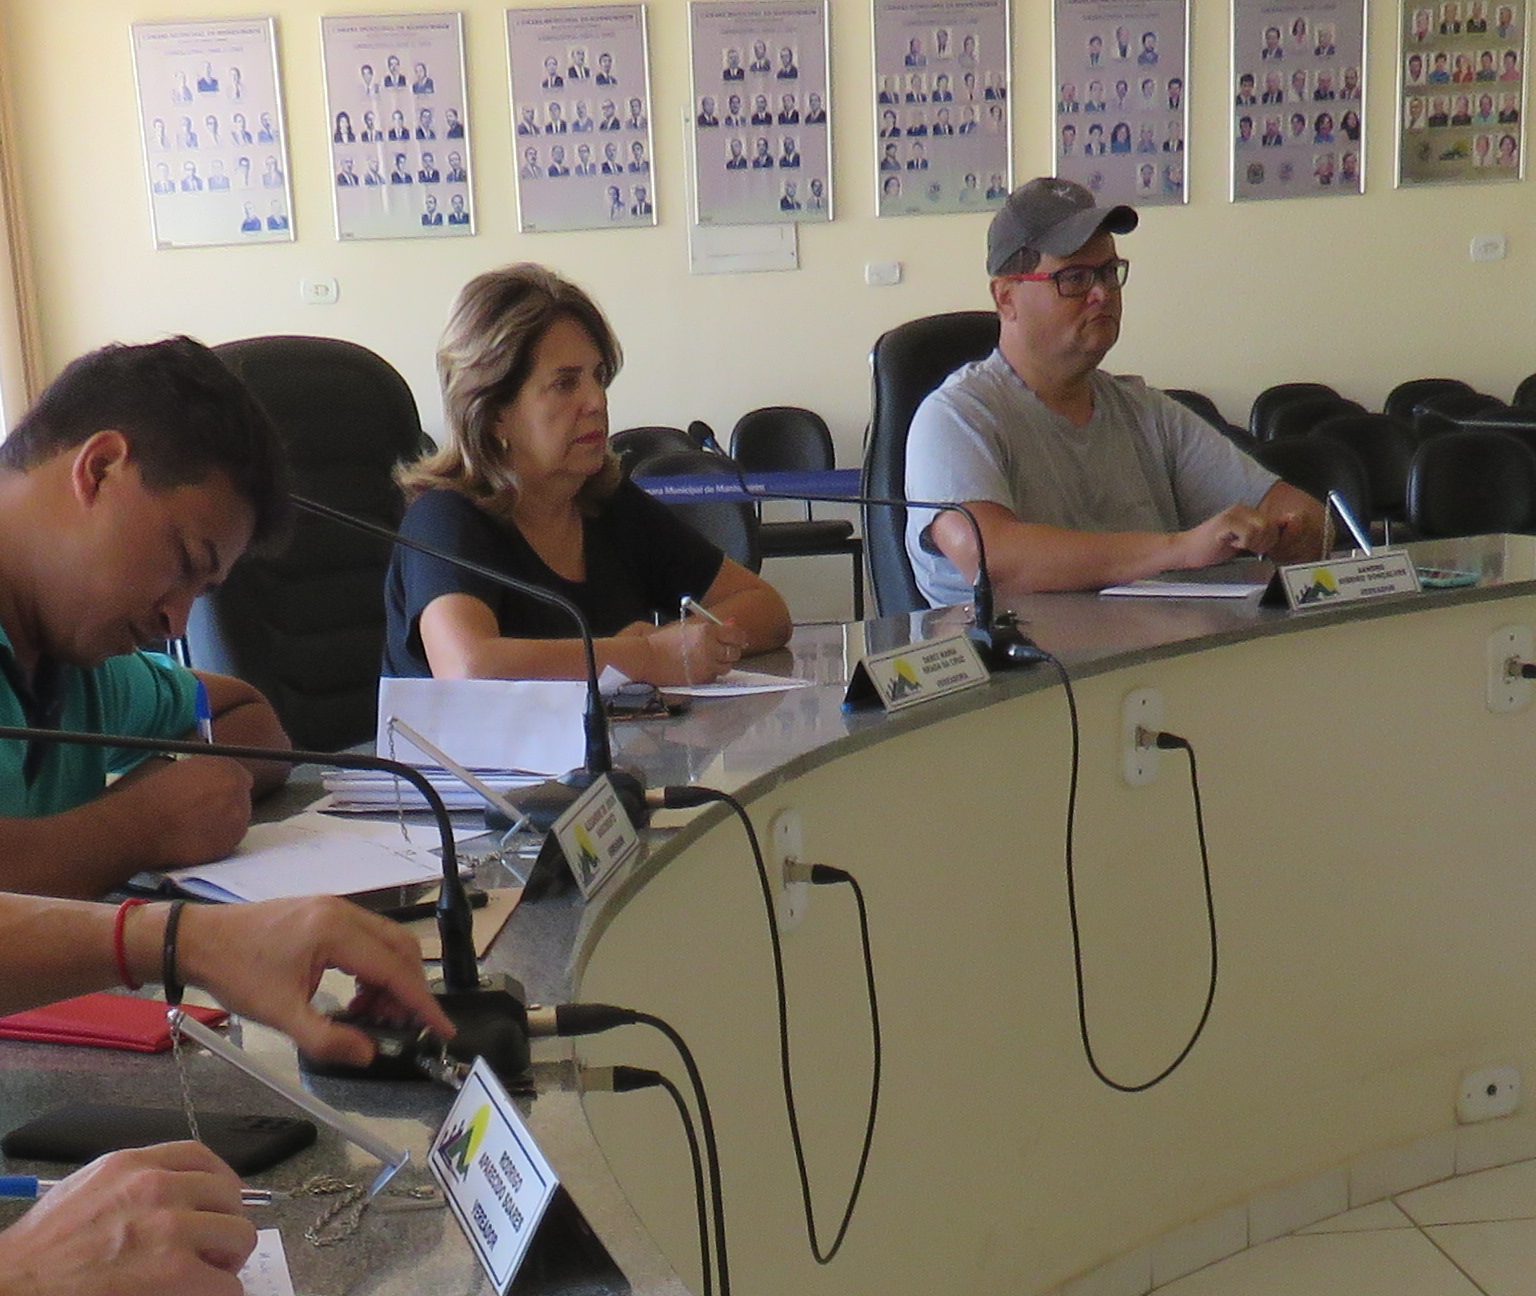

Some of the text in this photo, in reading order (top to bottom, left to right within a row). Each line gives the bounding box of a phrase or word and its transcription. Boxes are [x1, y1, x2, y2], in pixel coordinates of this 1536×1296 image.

[478, 1152, 525, 1234] APARECIDO SOARES
[499, 1150, 524, 1194] RODRIGO
[471, 1199, 499, 1253] VEREADOR
